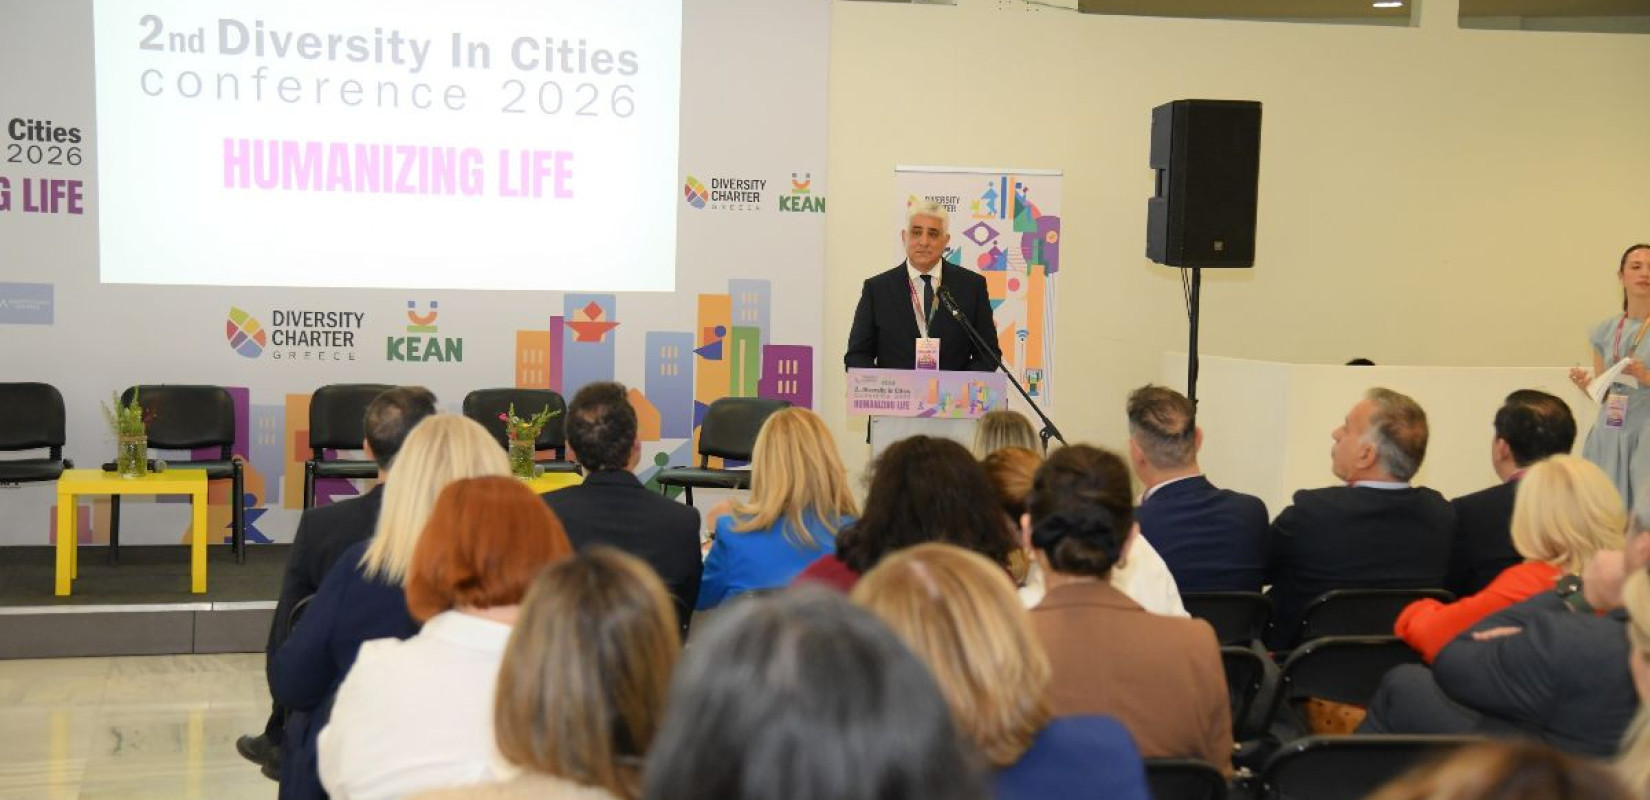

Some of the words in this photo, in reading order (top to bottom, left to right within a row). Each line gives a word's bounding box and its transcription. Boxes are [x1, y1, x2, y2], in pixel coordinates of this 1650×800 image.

[138, 14, 205, 54] 2nd
[217, 18, 431, 74] Diversity
[451, 32, 491, 69] In
[510, 36, 640, 77] Cities
[140, 66, 467, 112] conference
[501, 79, 636, 119] 2026
[8, 117, 83, 144] Cities
[7, 143, 83, 167] 2026
[223, 137, 484, 197] HUMANIZING
[499, 149, 574, 199] LIFE
[22, 177, 84, 215] LIFE
[711, 178, 767, 191] DIVERSITY
[711, 190, 760, 203] CHARTER
[779, 195, 826, 213] KEAN
[272, 310, 365, 329] DIVERSITY
[271, 330, 354, 347] CHARTER
[387, 336, 463, 362] KEAN
[272, 351, 356, 361] GREECE
